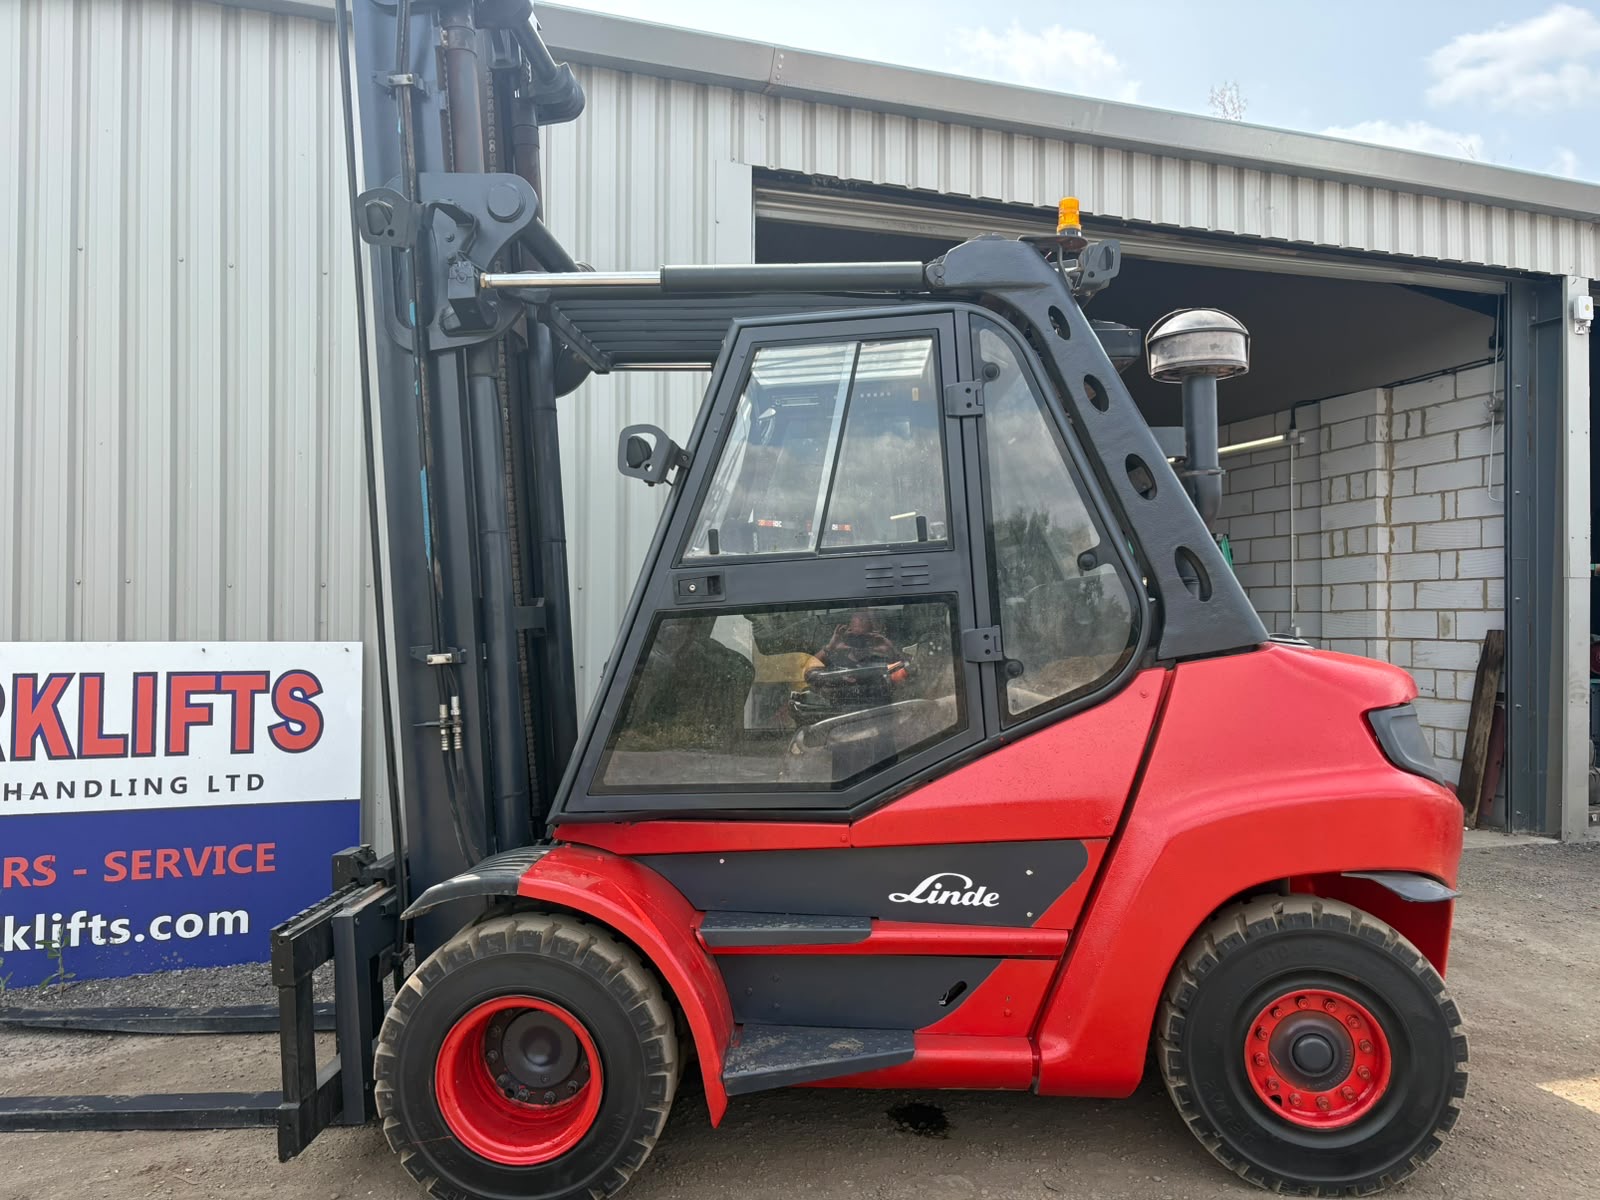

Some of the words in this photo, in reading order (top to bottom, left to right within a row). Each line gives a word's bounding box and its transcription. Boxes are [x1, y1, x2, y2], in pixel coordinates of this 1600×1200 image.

[0, 669, 324, 761] KLIFTS
[4, 776, 189, 801] HANDLING
[207, 773, 265, 793] LTD
[3, 854, 57, 888] RS
[104, 842, 277, 883] SERVICE
[888, 872, 1000, 907] Linde
[4, 909, 249, 952] klifts.com
